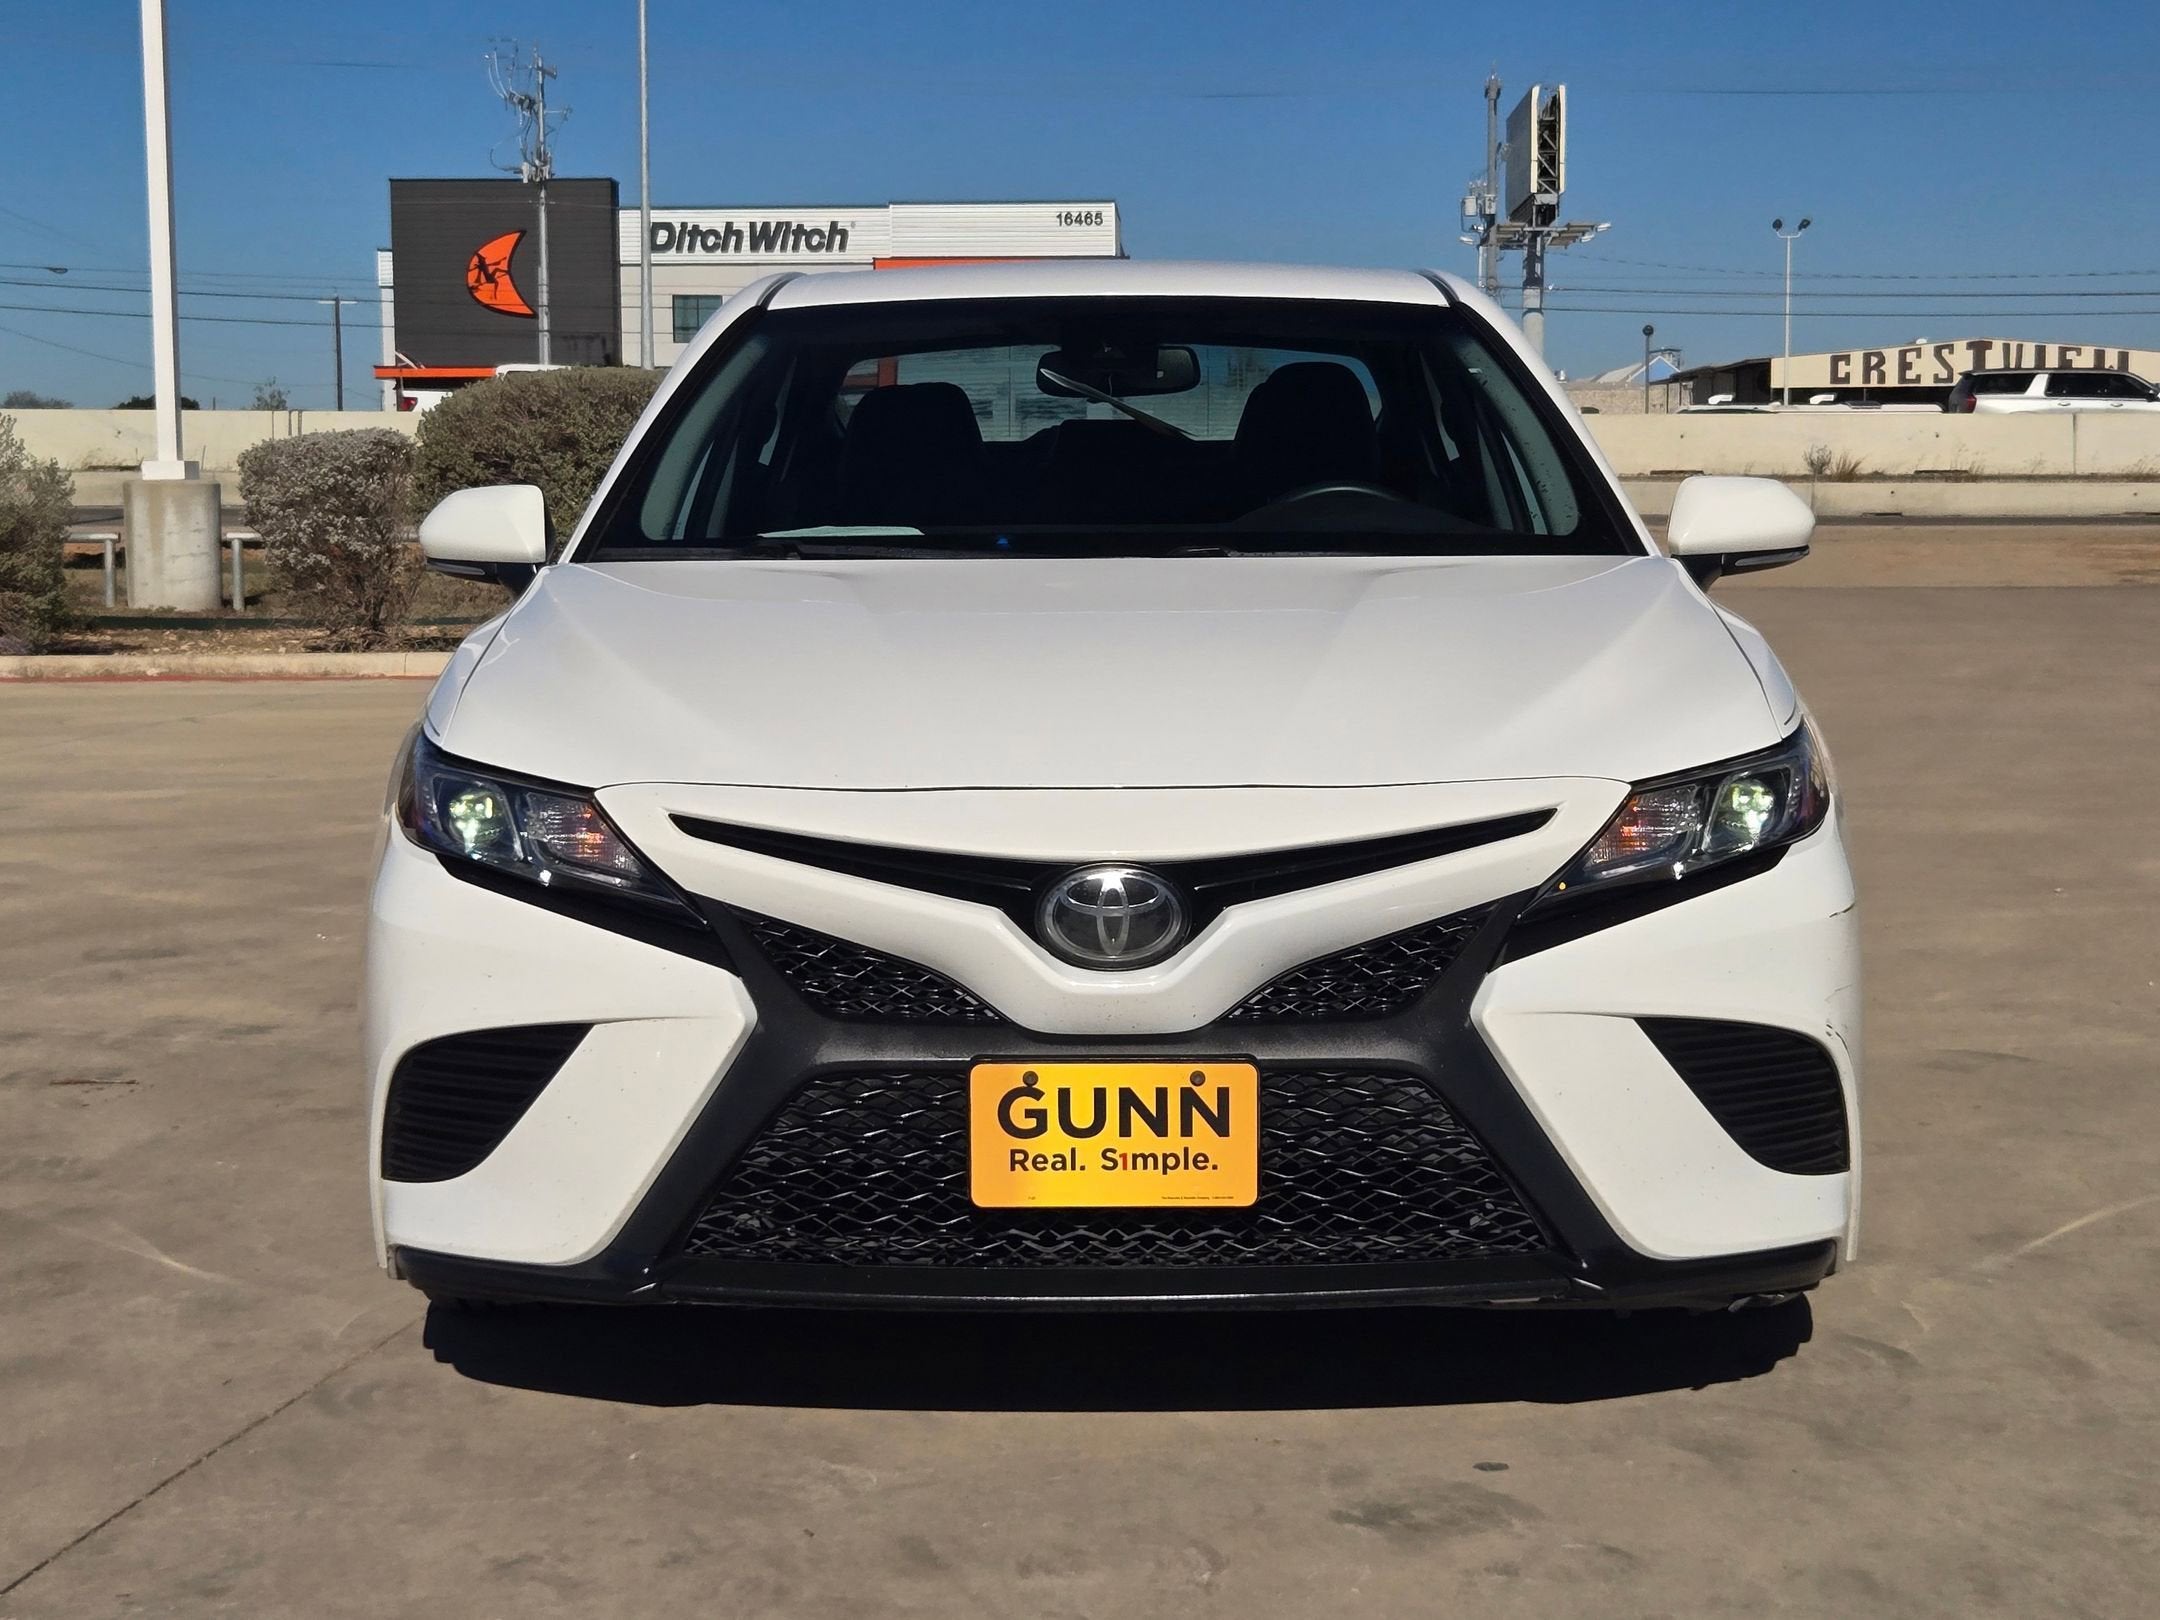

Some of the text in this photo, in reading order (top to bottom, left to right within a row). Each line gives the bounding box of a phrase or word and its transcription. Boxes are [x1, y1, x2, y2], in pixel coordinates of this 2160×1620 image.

[1056, 211, 1103, 227] 16465
[651, 221, 849, 253] Ditch Witch
[1829, 340, 2130, 385] CRESTVIEW
[997, 1086, 1231, 1139] GUNN
[1010, 1148, 1086, 1172] Real.
